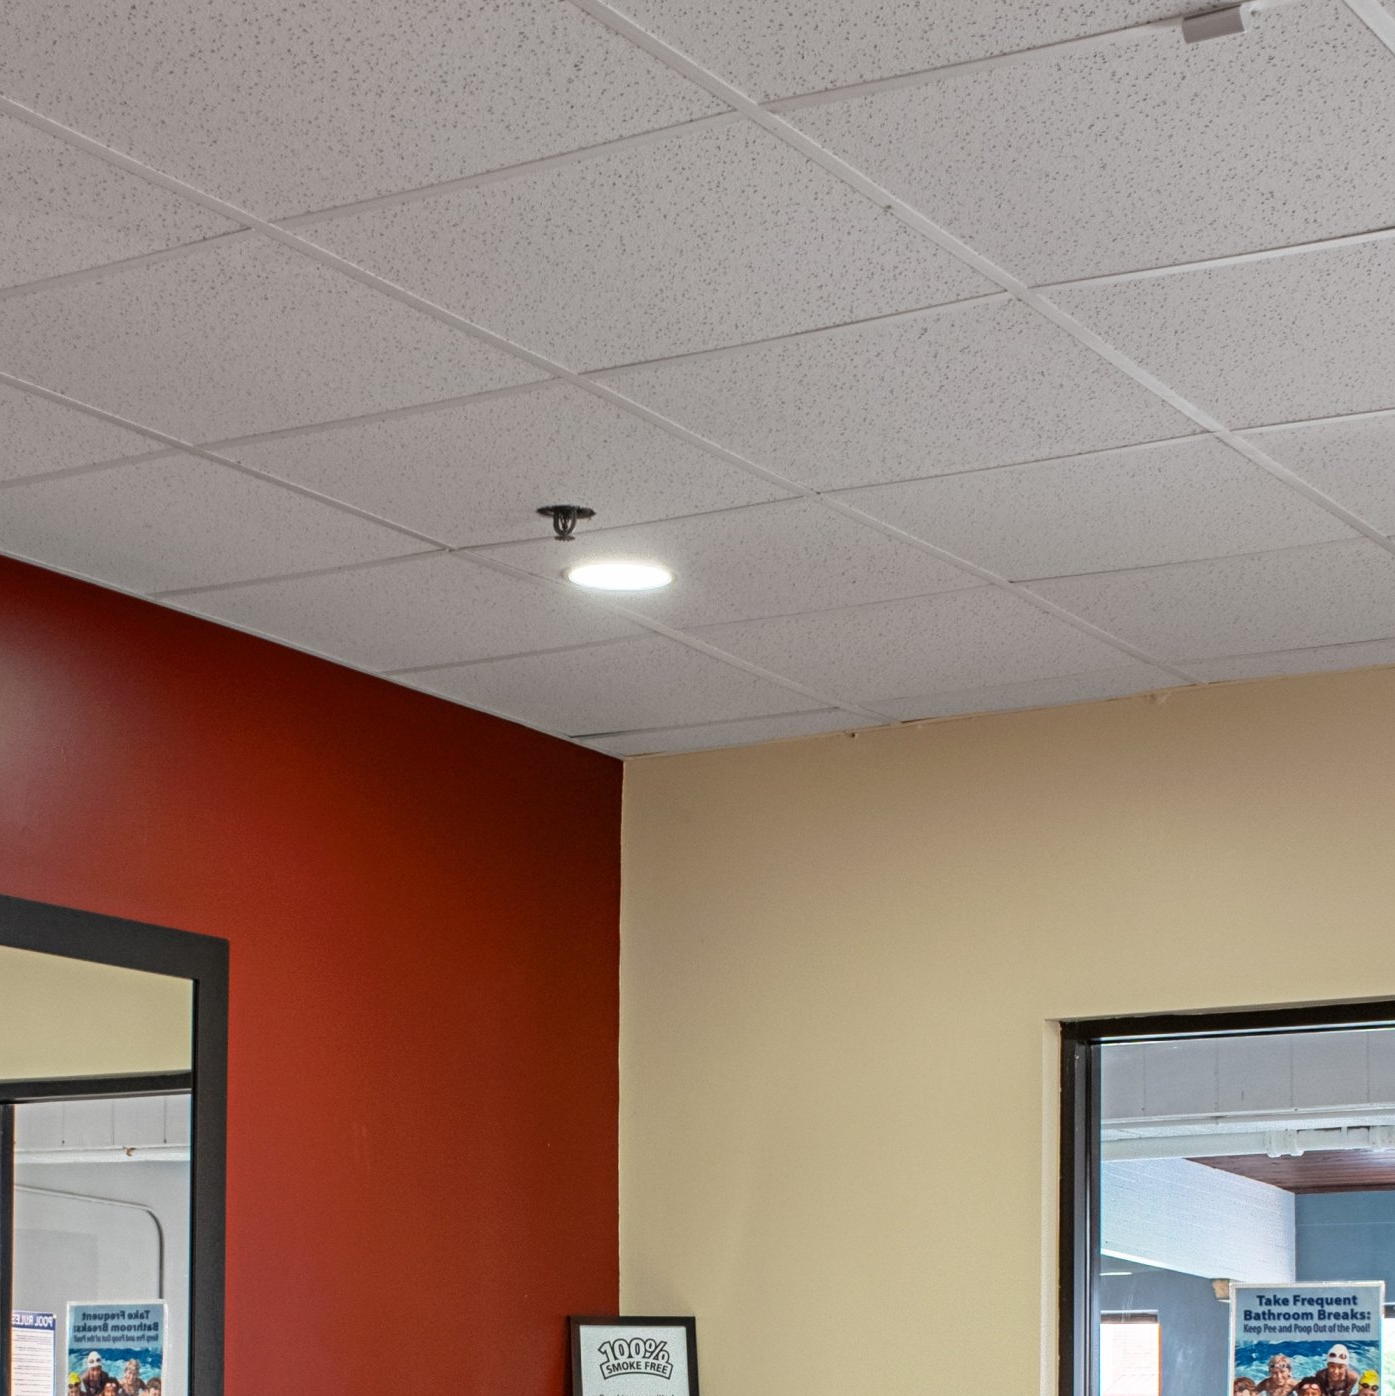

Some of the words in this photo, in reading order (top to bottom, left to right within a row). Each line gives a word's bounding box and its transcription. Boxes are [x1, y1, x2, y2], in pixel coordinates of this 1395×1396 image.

[1257, 1294, 1289, 1306] Take
[1293, 1294, 1358, 1308] Frequent
[1244, 1309, 1313, 1321] Bathroom
[1318, 1309, 1371, 1321] Breaks:
[1243, 1323, 1262, 1335] Keep
[1263, 1323, 1277, 1333] Pee
[1278, 1323, 1292, 1333] and
[1294, 1323, 1312, 1335] Poop
[1313, 1323, 1327, 1333] Out
[1328, 1323, 1337, 1333] of
[1337, 1323, 1350, 1333] the
[1351, 1322, 1371, 1333] Pool!
[598, 1338, 670, 1362] 100%
[606, 1361, 642, 1374] SMOKE
[645, 1361, 669, 1375] FREE
